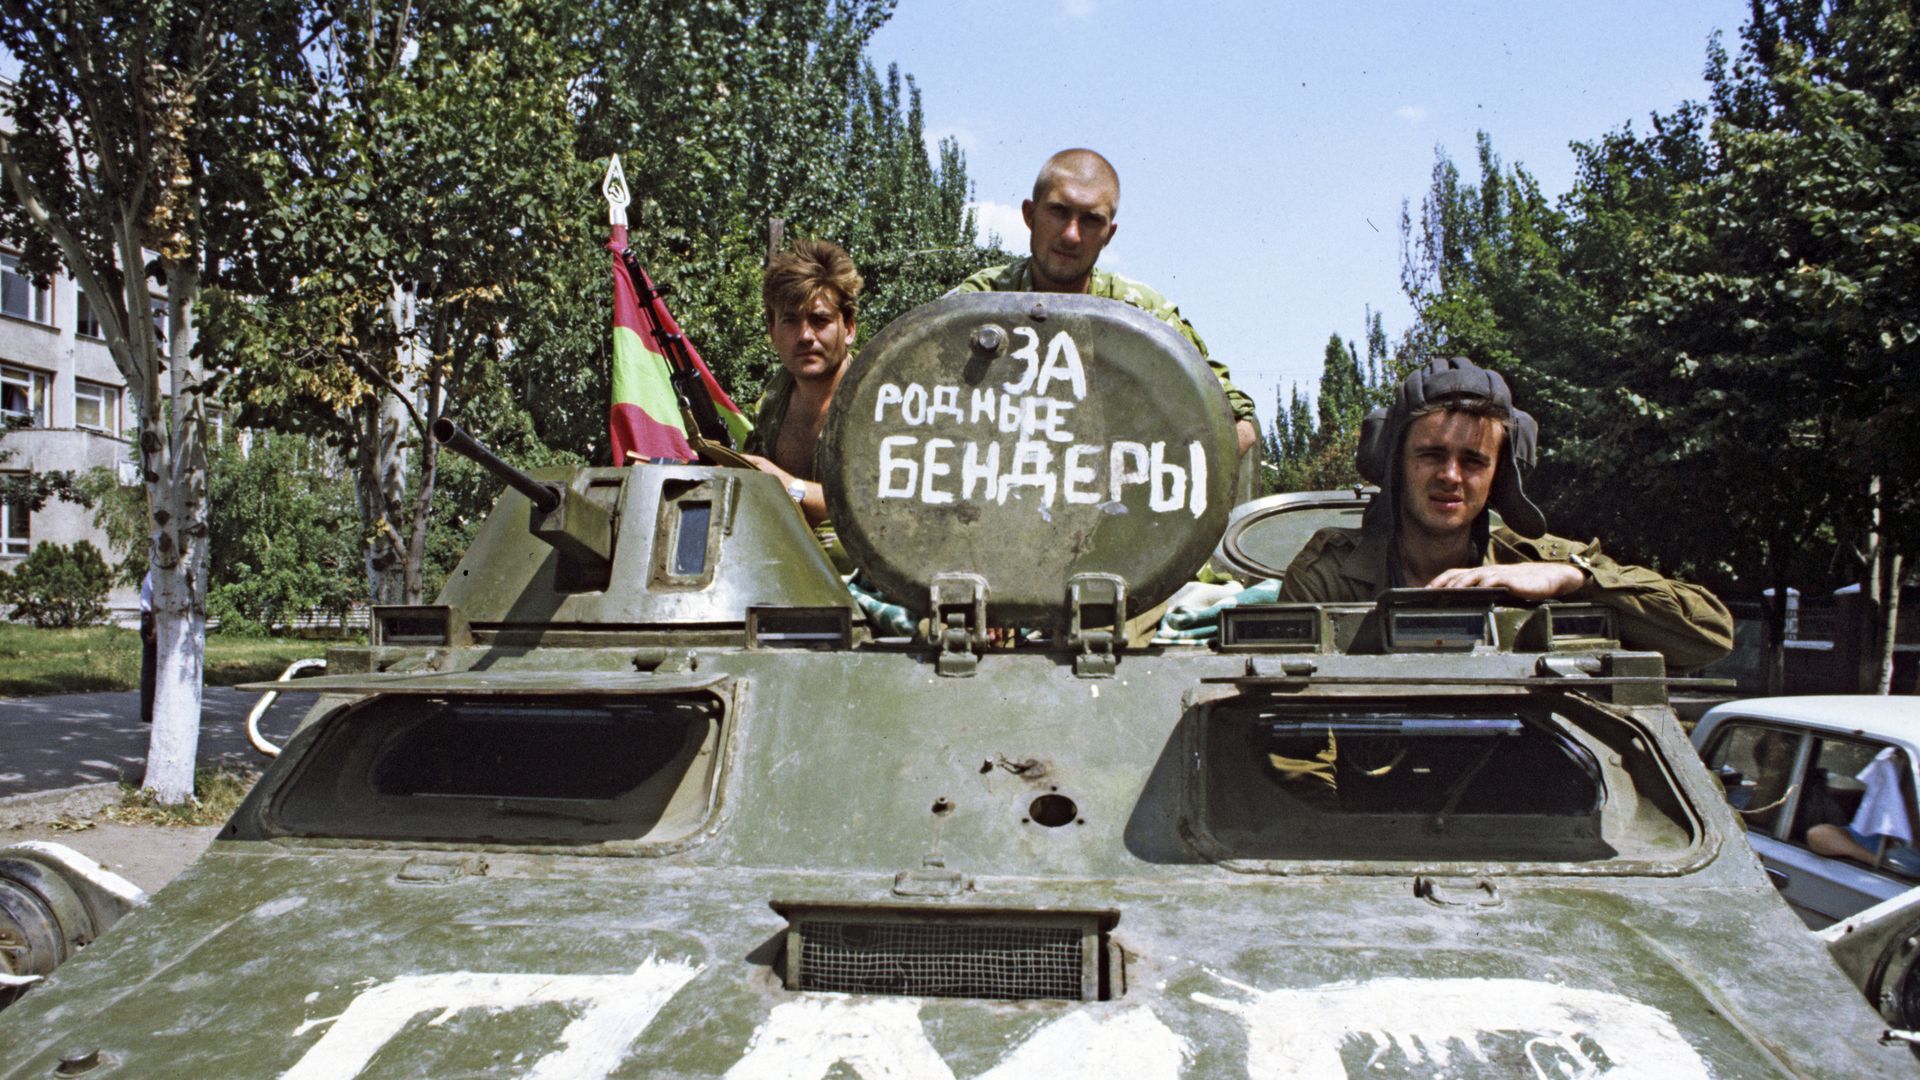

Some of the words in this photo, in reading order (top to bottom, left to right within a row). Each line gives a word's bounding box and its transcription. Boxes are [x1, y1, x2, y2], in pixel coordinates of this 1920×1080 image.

[1003, 327, 1086, 400] ЗА
[875, 383, 1075, 442] РОДНЫЕ
[878, 437, 1207, 518] БЕНДЕРЫ
